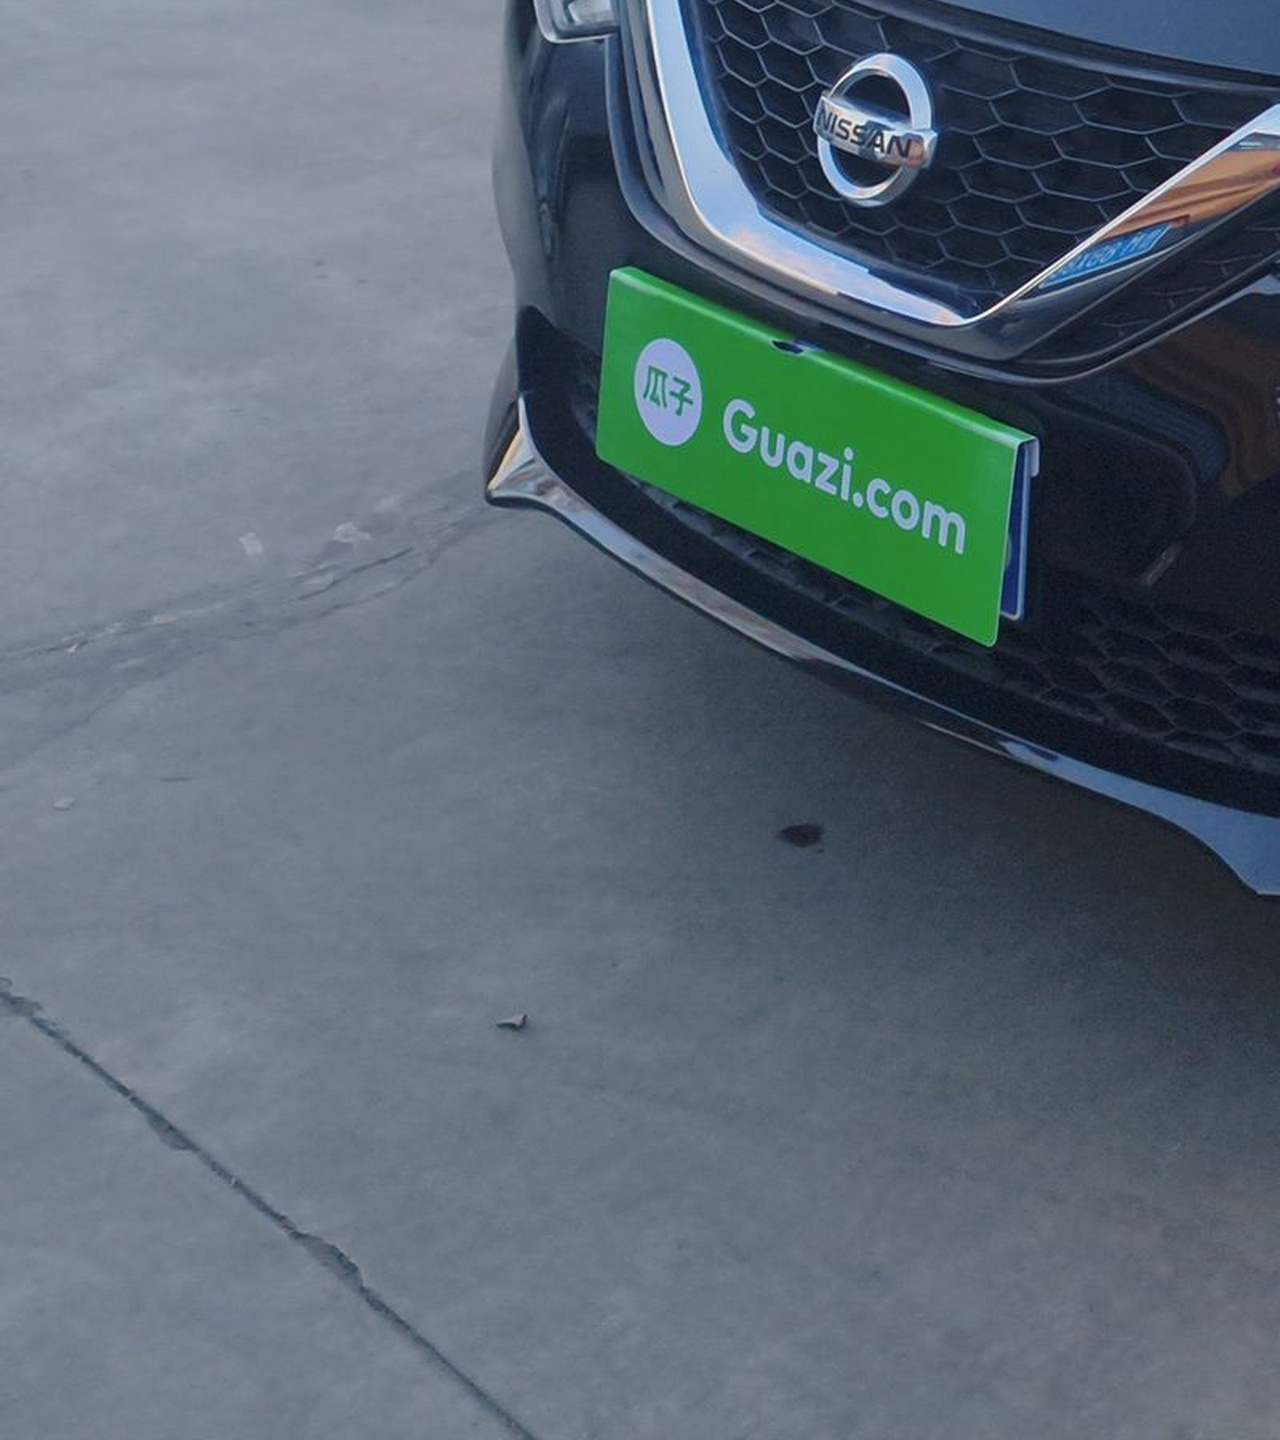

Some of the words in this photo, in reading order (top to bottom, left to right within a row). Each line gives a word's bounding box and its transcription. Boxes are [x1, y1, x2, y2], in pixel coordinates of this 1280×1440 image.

[817, 102, 913, 159] NISSAN
[642, 364, 694, 417] 瓜子
[722, 398, 967, 555] Guazi.com
